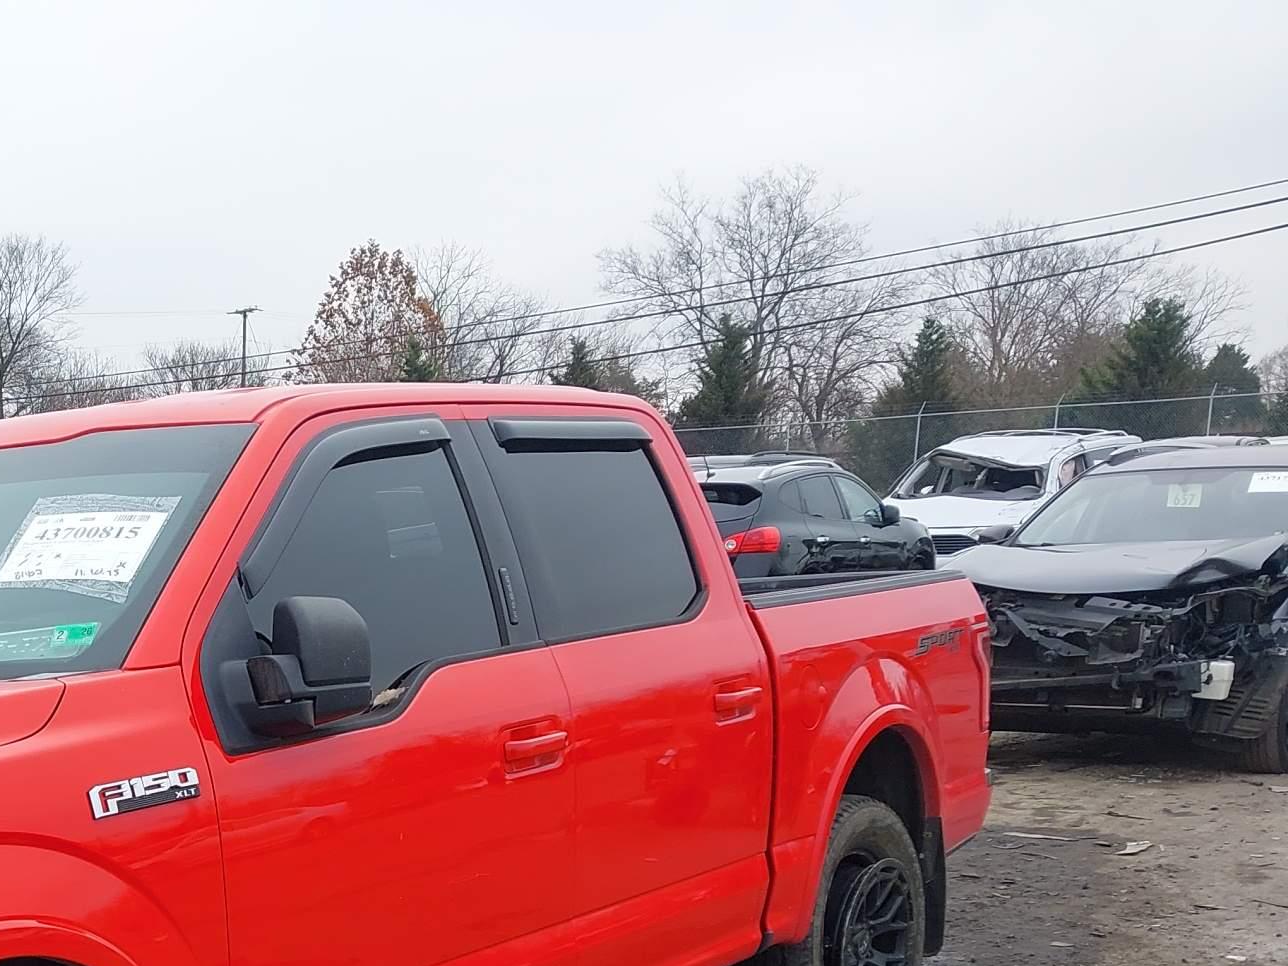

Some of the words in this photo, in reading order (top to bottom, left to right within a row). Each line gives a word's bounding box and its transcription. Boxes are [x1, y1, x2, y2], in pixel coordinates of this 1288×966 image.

[34, 525, 143, 541] 43700815
[56, 630, 65, 640] 2
[914, 628, 965, 656] SPORT
[174, 787, 197, 799] XLT
